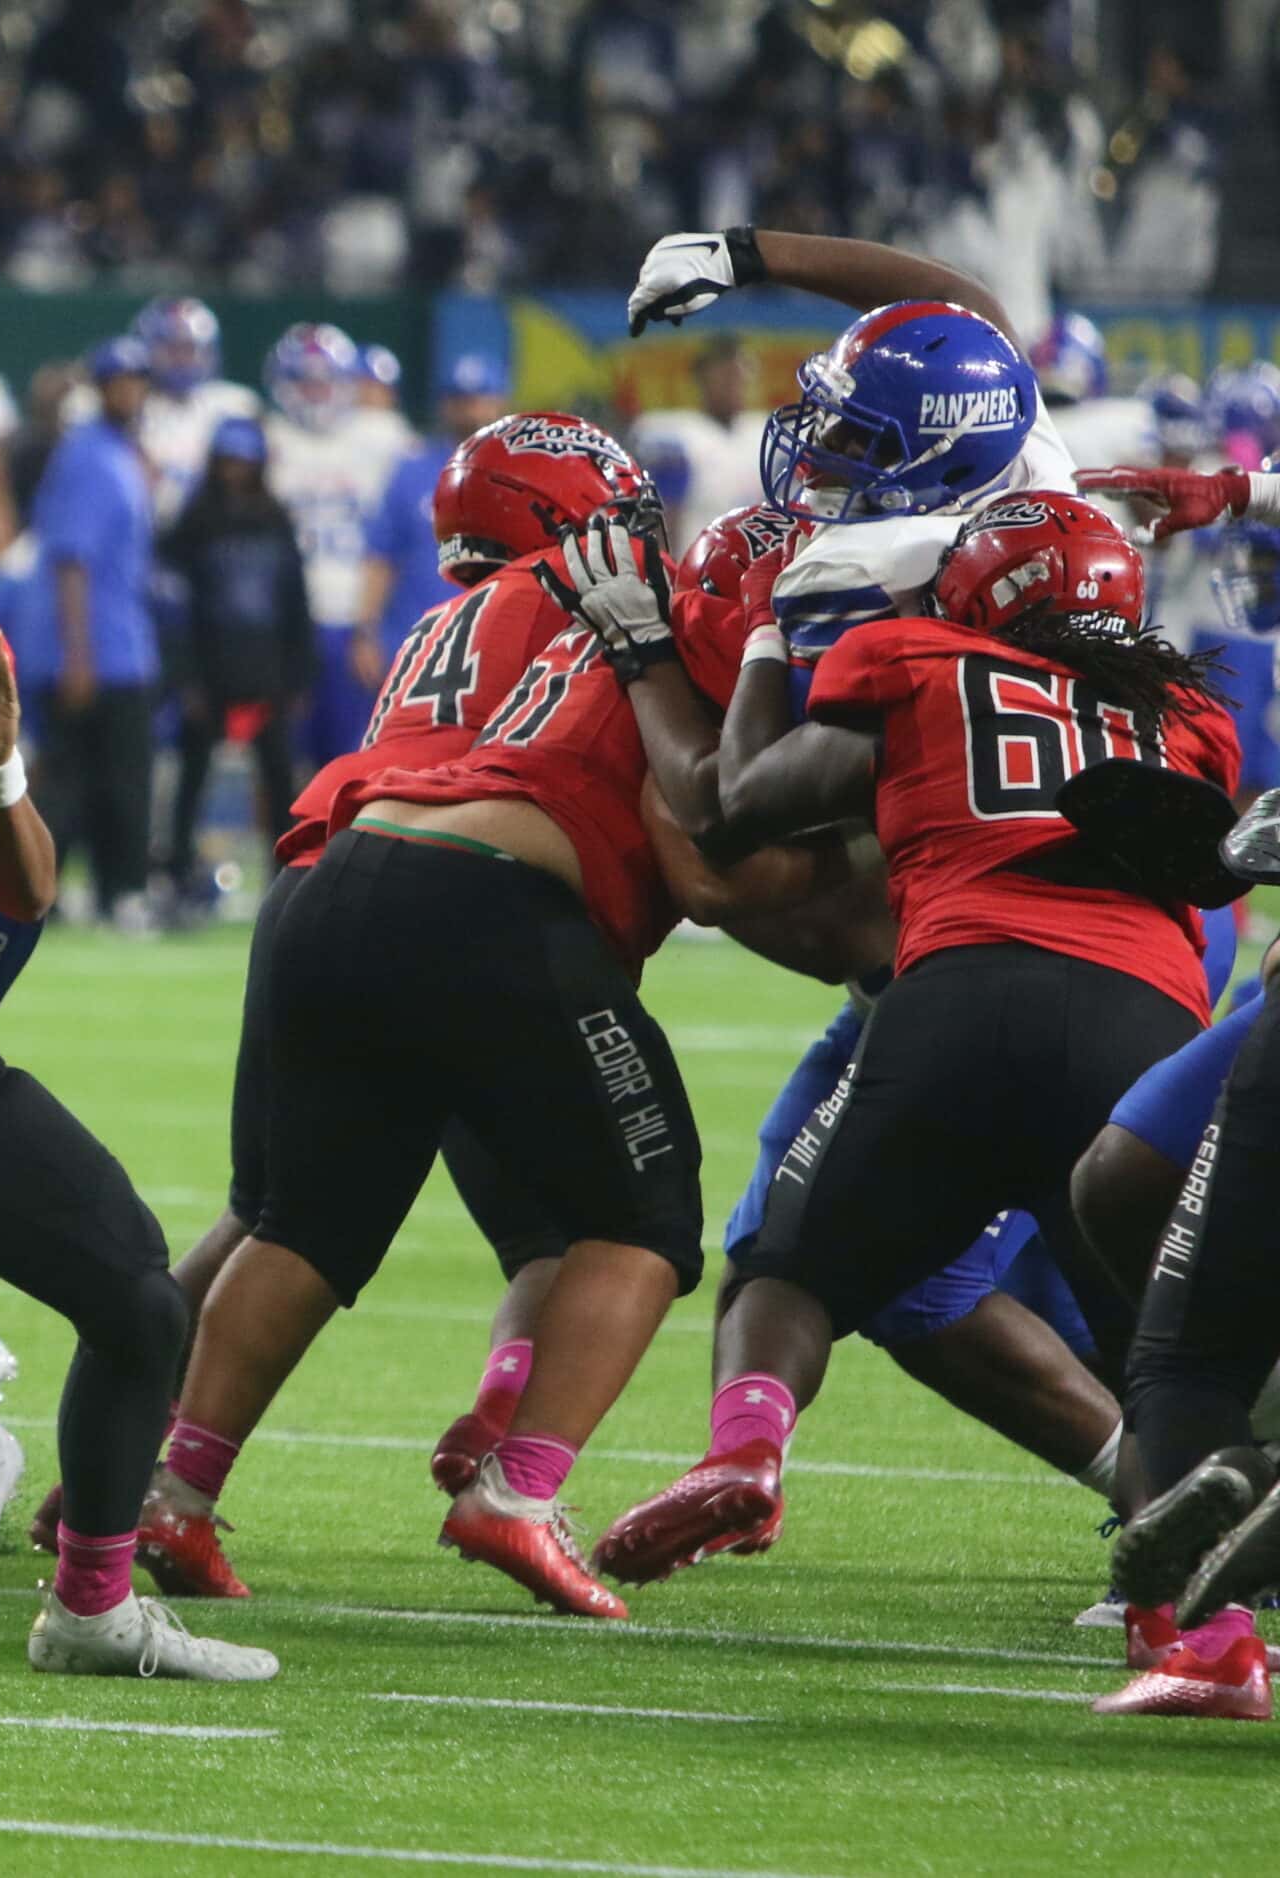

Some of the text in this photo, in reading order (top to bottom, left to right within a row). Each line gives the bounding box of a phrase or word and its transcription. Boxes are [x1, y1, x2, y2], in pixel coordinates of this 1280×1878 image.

[919, 386, 1017, 425] PANTHERS
[1076, 580, 1099, 600] 60
[359, 579, 500, 753] 74
[577, 1008, 674, 1173] CEDAR HILL
[775, 1126, 821, 1185] HILL
[1153, 1124, 1221, 1281] CEDAR HILL
